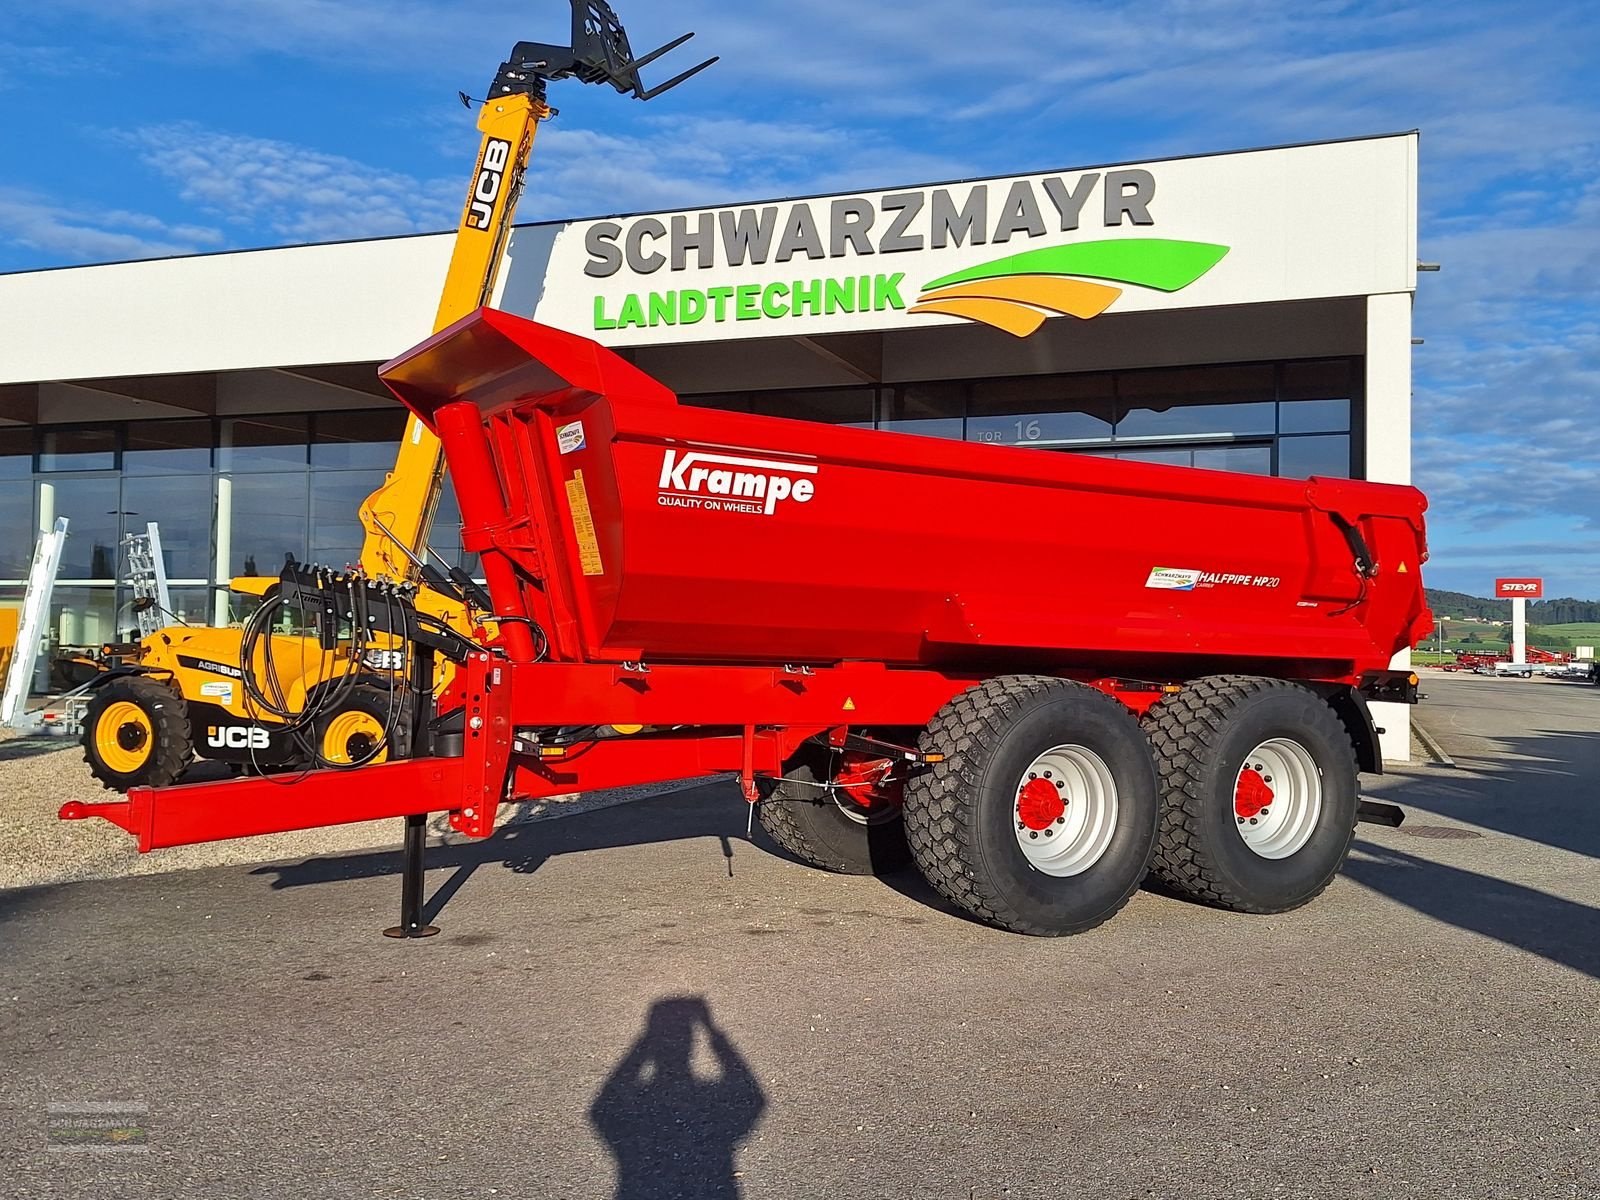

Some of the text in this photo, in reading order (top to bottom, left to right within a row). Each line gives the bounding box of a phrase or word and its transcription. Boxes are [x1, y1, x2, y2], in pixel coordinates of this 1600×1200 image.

[467, 140, 509, 229] JCB
[583, 168, 1157, 278] SCHWARZMAYR
[593, 272, 907, 331] LANDTECHNIK
[977, 431, 1002, 442] TOR
[1014, 420, 1041, 440] 16
[658, 449, 819, 515] Krampe
[657, 496, 763, 514] QUALITY ON WHEELS
[1199, 571, 1281, 588] HALFPIPE HP20
[1501, 583, 1538, 592] STEYR
[197, 660, 243, 678] AGRISUP
[207, 725, 271, 749] JCB
